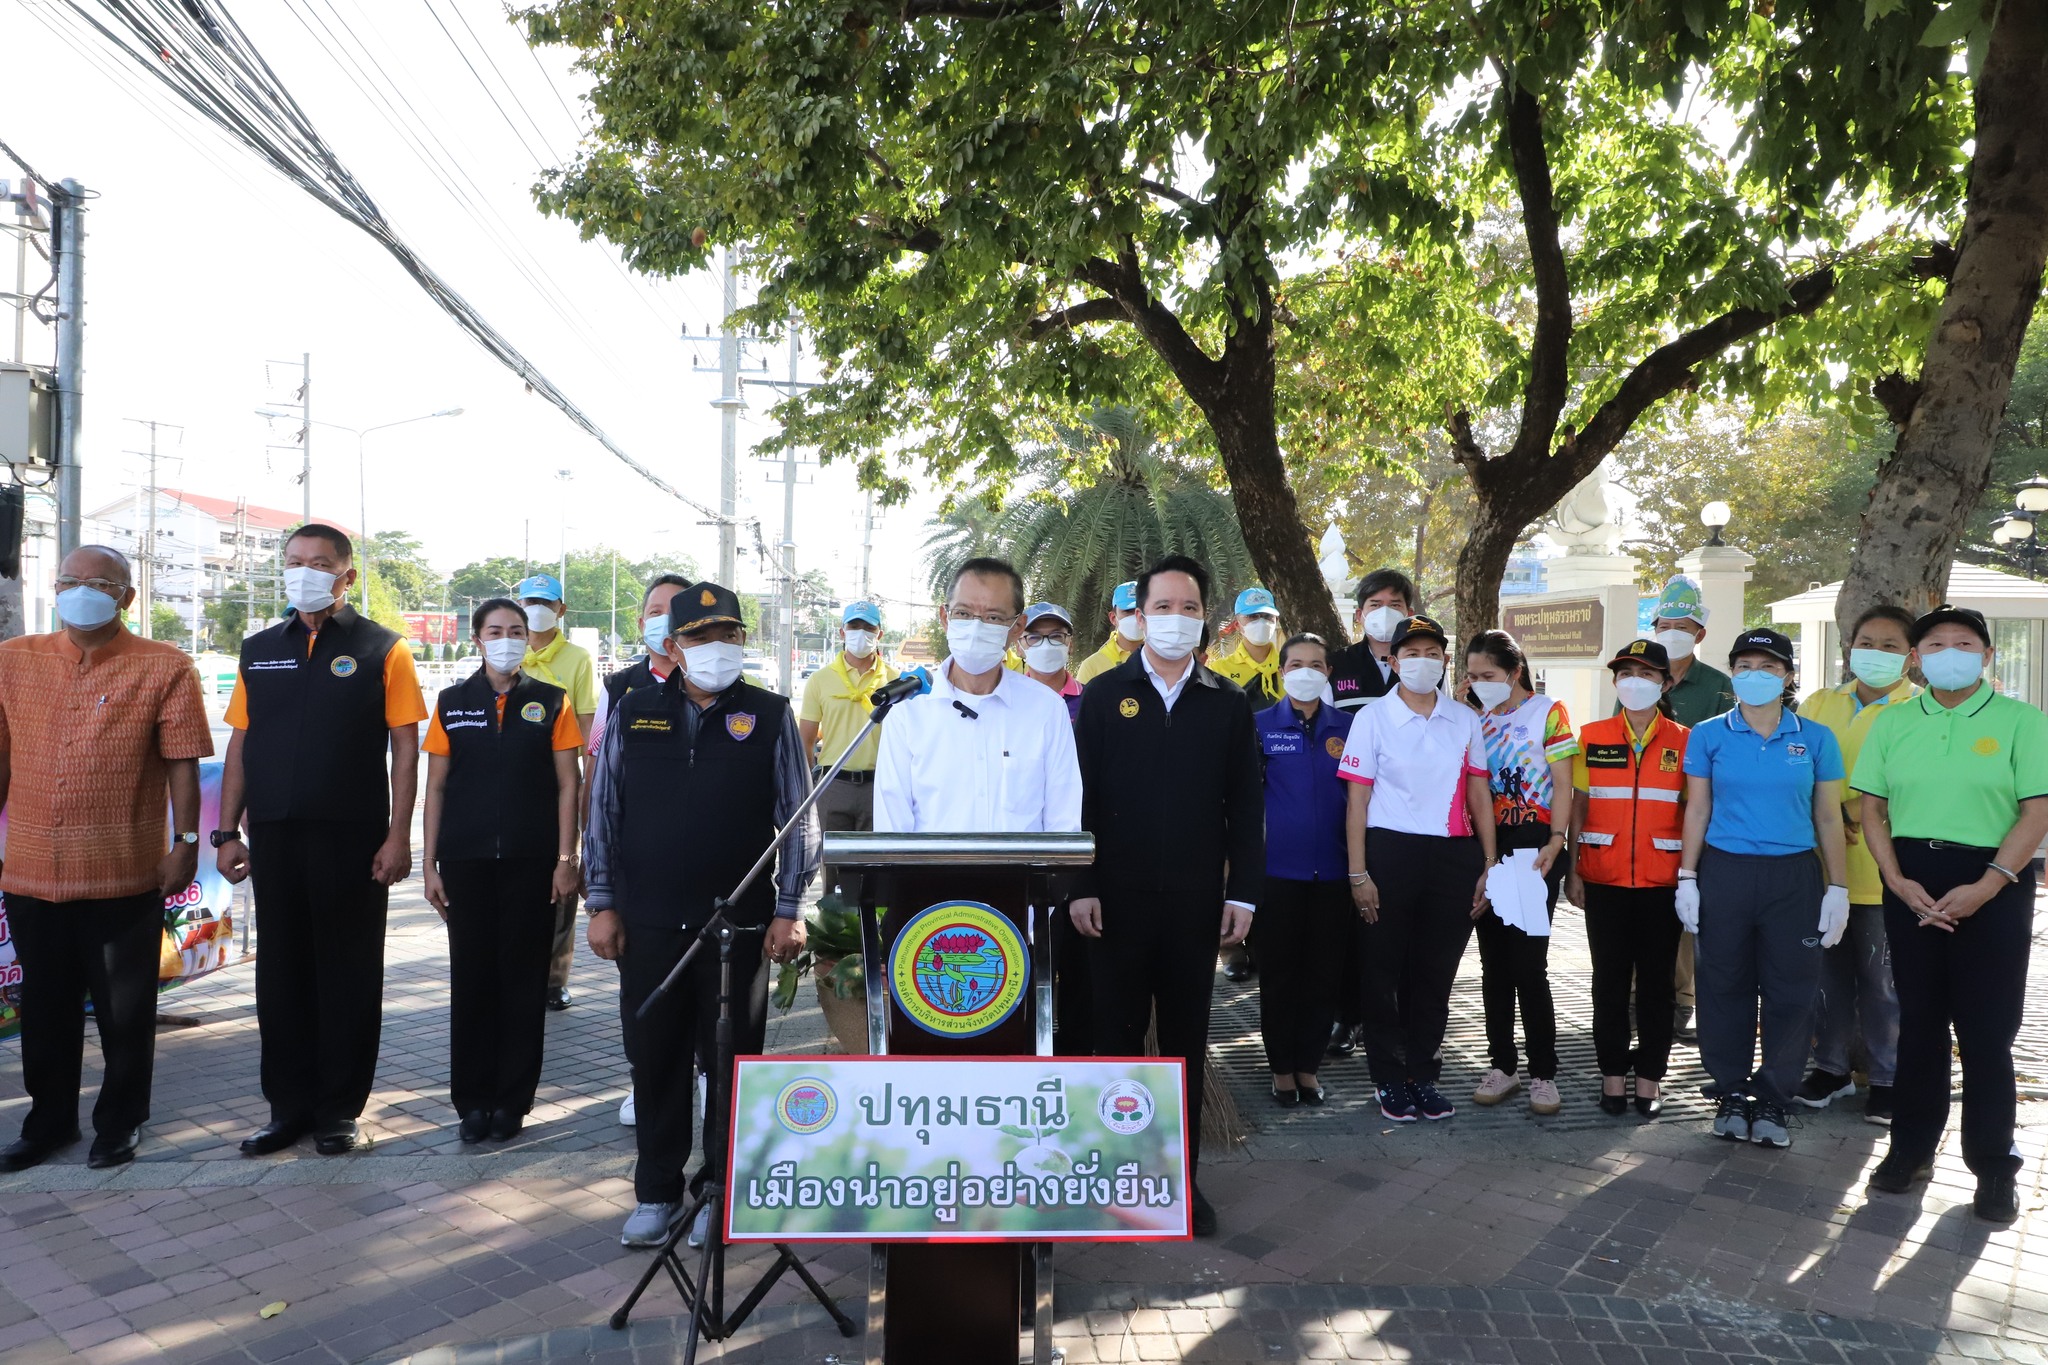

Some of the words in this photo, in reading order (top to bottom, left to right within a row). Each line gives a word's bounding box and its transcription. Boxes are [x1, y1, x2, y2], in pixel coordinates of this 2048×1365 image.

[1678, 602, 1696, 611] OFF
[1748, 636, 1772, 644] NSO
[1337, 679, 1359, 691] พม.
[1341, 754, 1360, 768] AB
[899, 929, 921, 969] Pathumthani
[920, 912, 952, 931] Provincial
[953, 911, 999, 931] Administrative
[998, 928, 1020, 968] Organization
[898, 979, 1019, 1029] องค์การบริหารส่วนจังหวัดปทุมธานี
[859, 1079, 1066, 1145] ปทุมธานี
[748, 1150, 1171, 1222] เมืองน่าอยู่อย่างยั่งยืน
